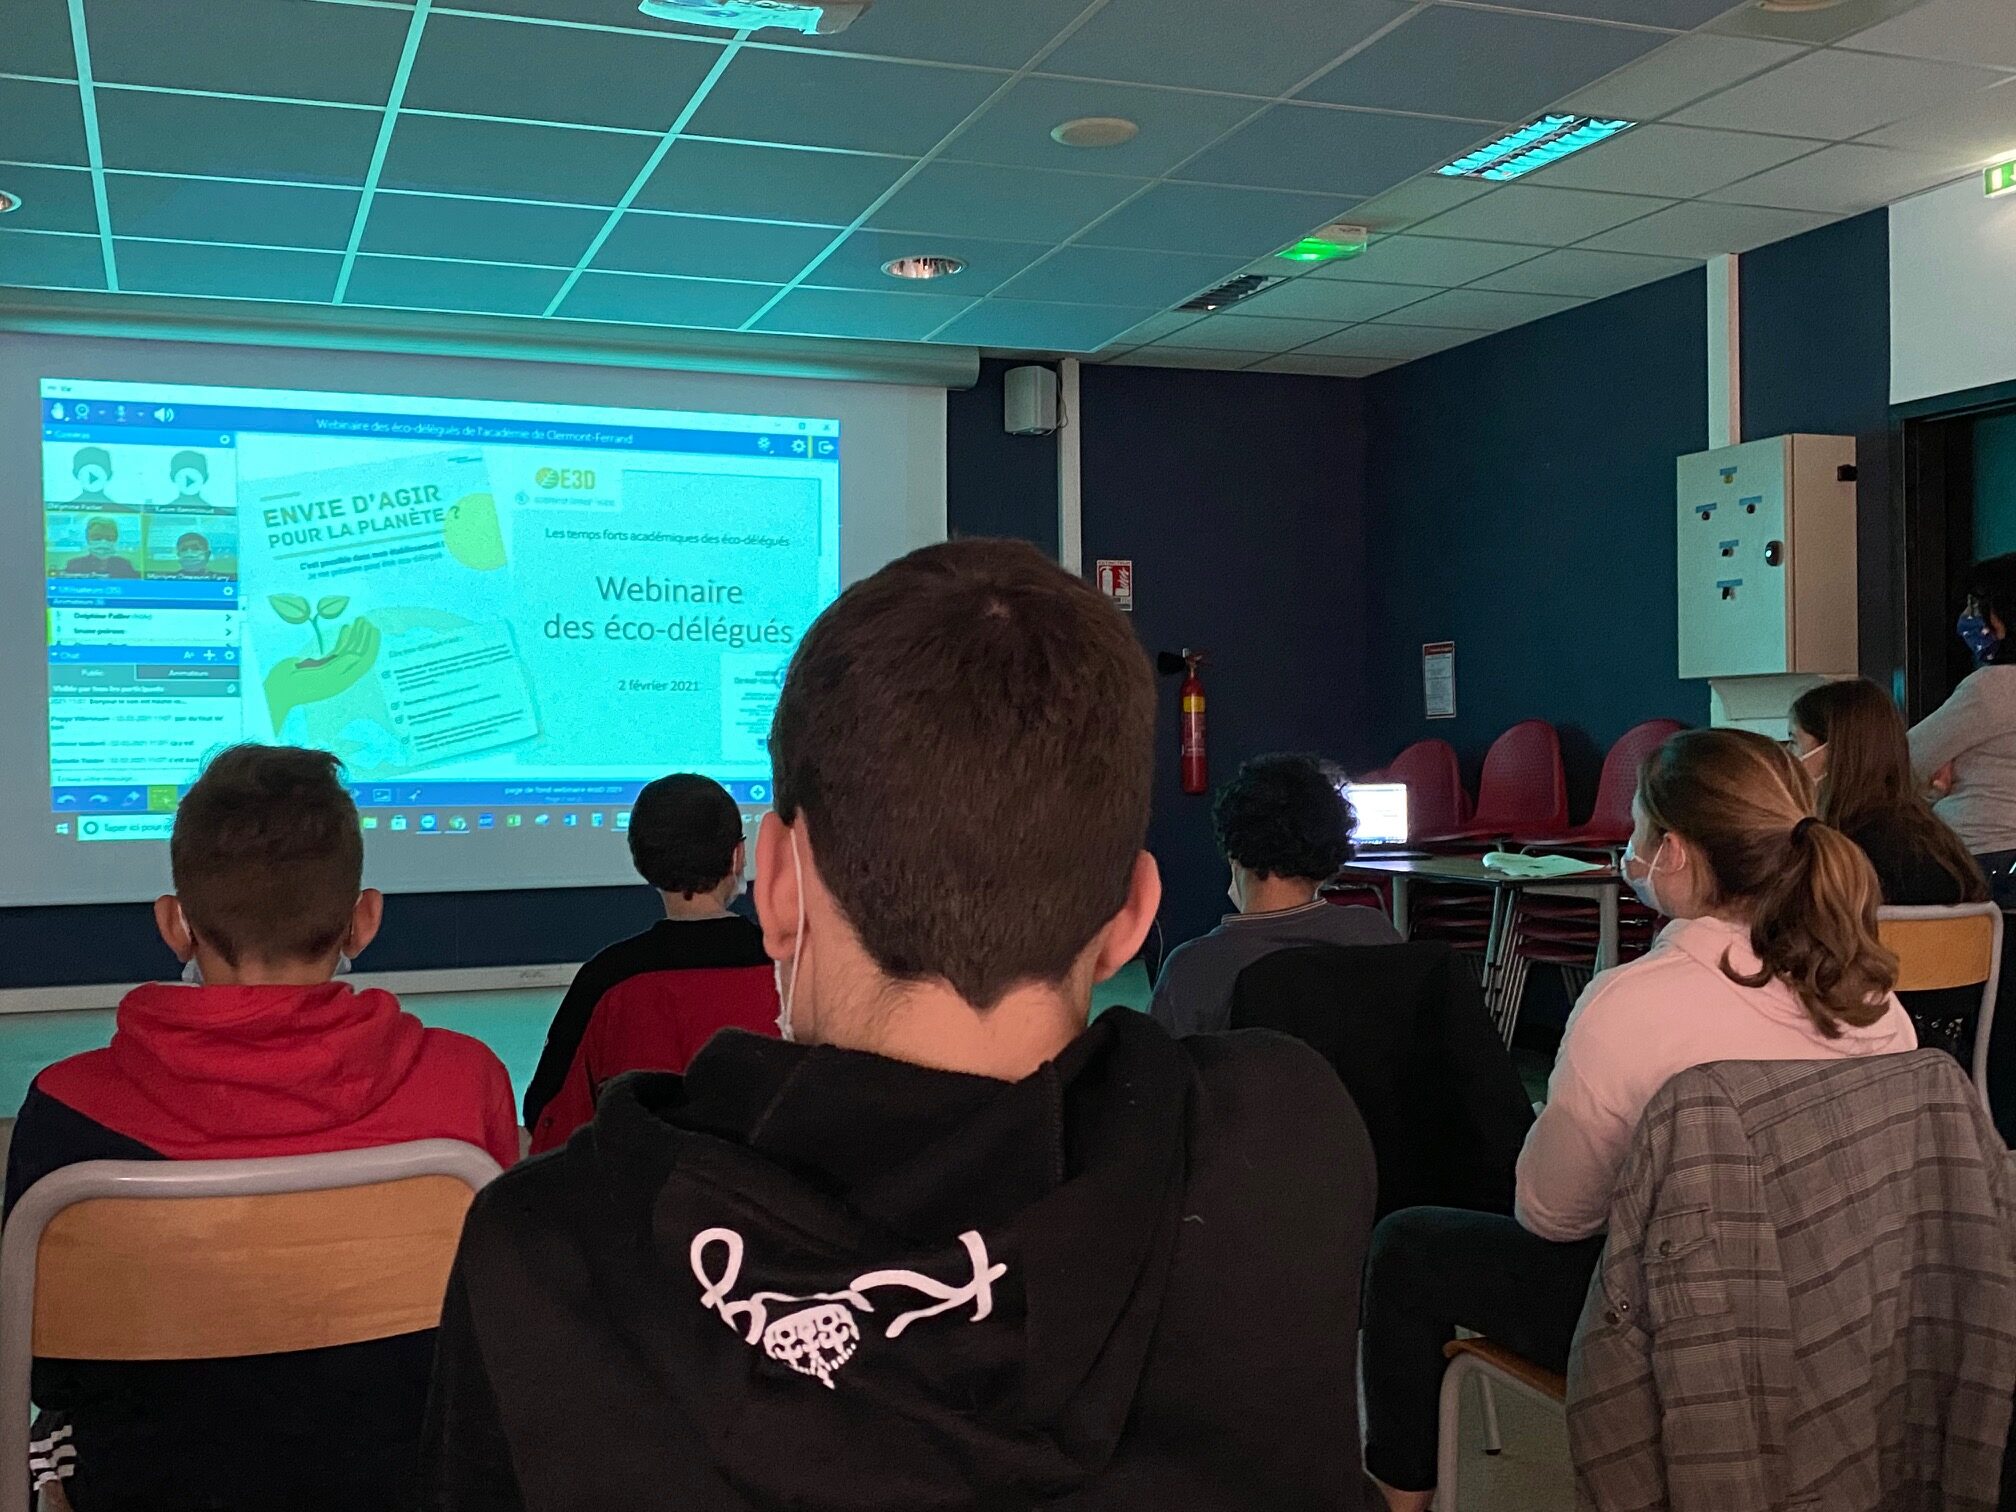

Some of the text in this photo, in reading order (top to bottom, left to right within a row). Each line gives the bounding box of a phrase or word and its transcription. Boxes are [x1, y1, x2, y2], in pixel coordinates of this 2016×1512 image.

[315, 418, 370, 431] Webinaire
[370, 421, 390, 432] des
[462, 425, 476, 437] de
[531, 428, 545, 440] de
[546, 429, 634, 444] Clermont-Ferrand
[560, 468, 596, 490] E3D
[262, 484, 443, 529] ENVIE D'AGIR
[268, 505, 461, 549] POUR LA PLANÈTE ?
[545, 527, 566, 539] Les
[566, 529, 601, 542] temps
[602, 529, 629, 541] forts
[630, 530, 700, 545] académiques
[700, 533, 721, 545] des
[596, 575, 745, 605] Webinaire
[543, 612, 795, 649] des éco-délégués
[617, 678, 700, 692] 2 février 2021
